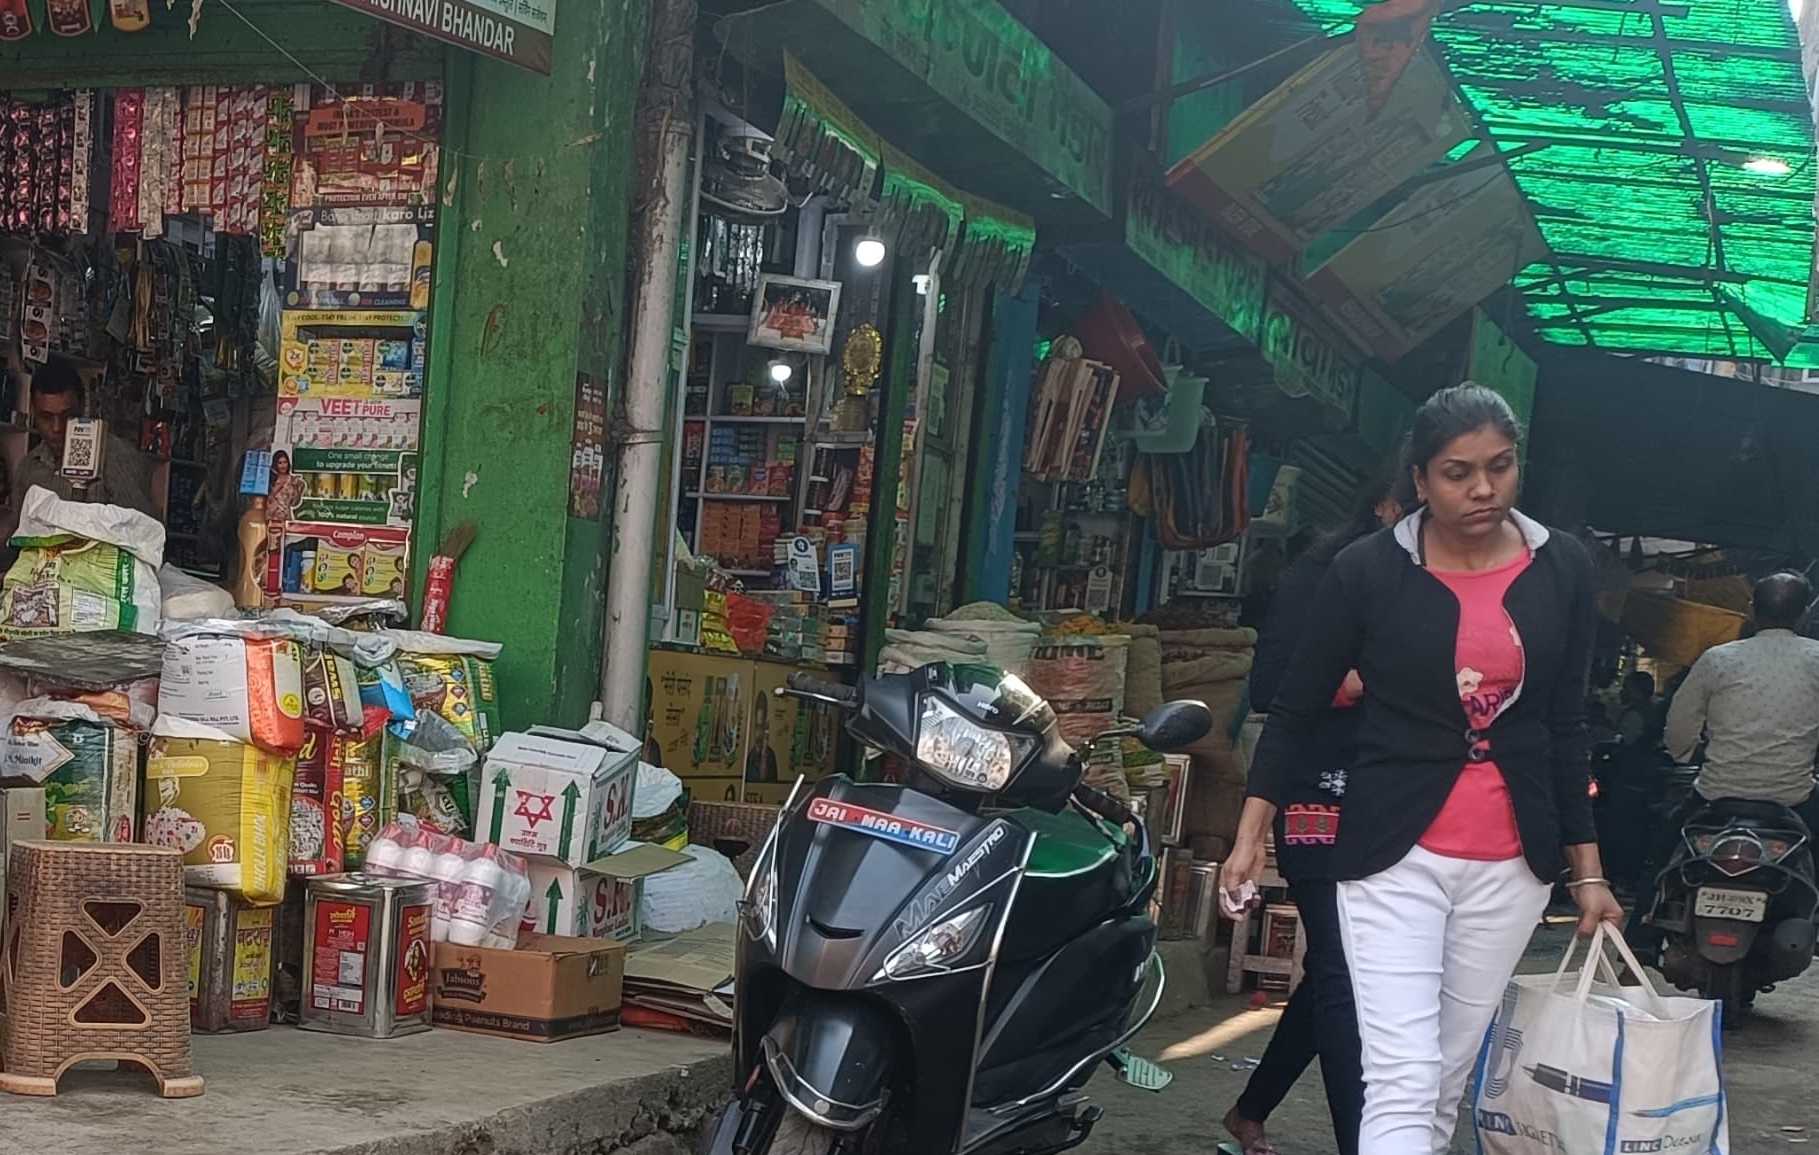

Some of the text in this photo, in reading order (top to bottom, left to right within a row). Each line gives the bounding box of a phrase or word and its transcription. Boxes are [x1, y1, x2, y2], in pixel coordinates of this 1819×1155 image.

[442, 1, 515, 56] BHANDAR
[382, 208, 414, 220] karo
[322, 399, 391, 415] VEET PURE
[328, 452, 342, 460] One
[344, 451, 362, 460] small
[323, 461, 356, 470] upgrade
[333, 530, 365, 541] Complan
[814, 804, 954, 850] JAI MAA KALI
[946, 826, 1005, 887] MAESTRO
[445, 972, 480, 986] Jabsons
[465, 1014, 530, 1031] Peanuts Brand
[1623, 1140, 1660, 1151] LINC
